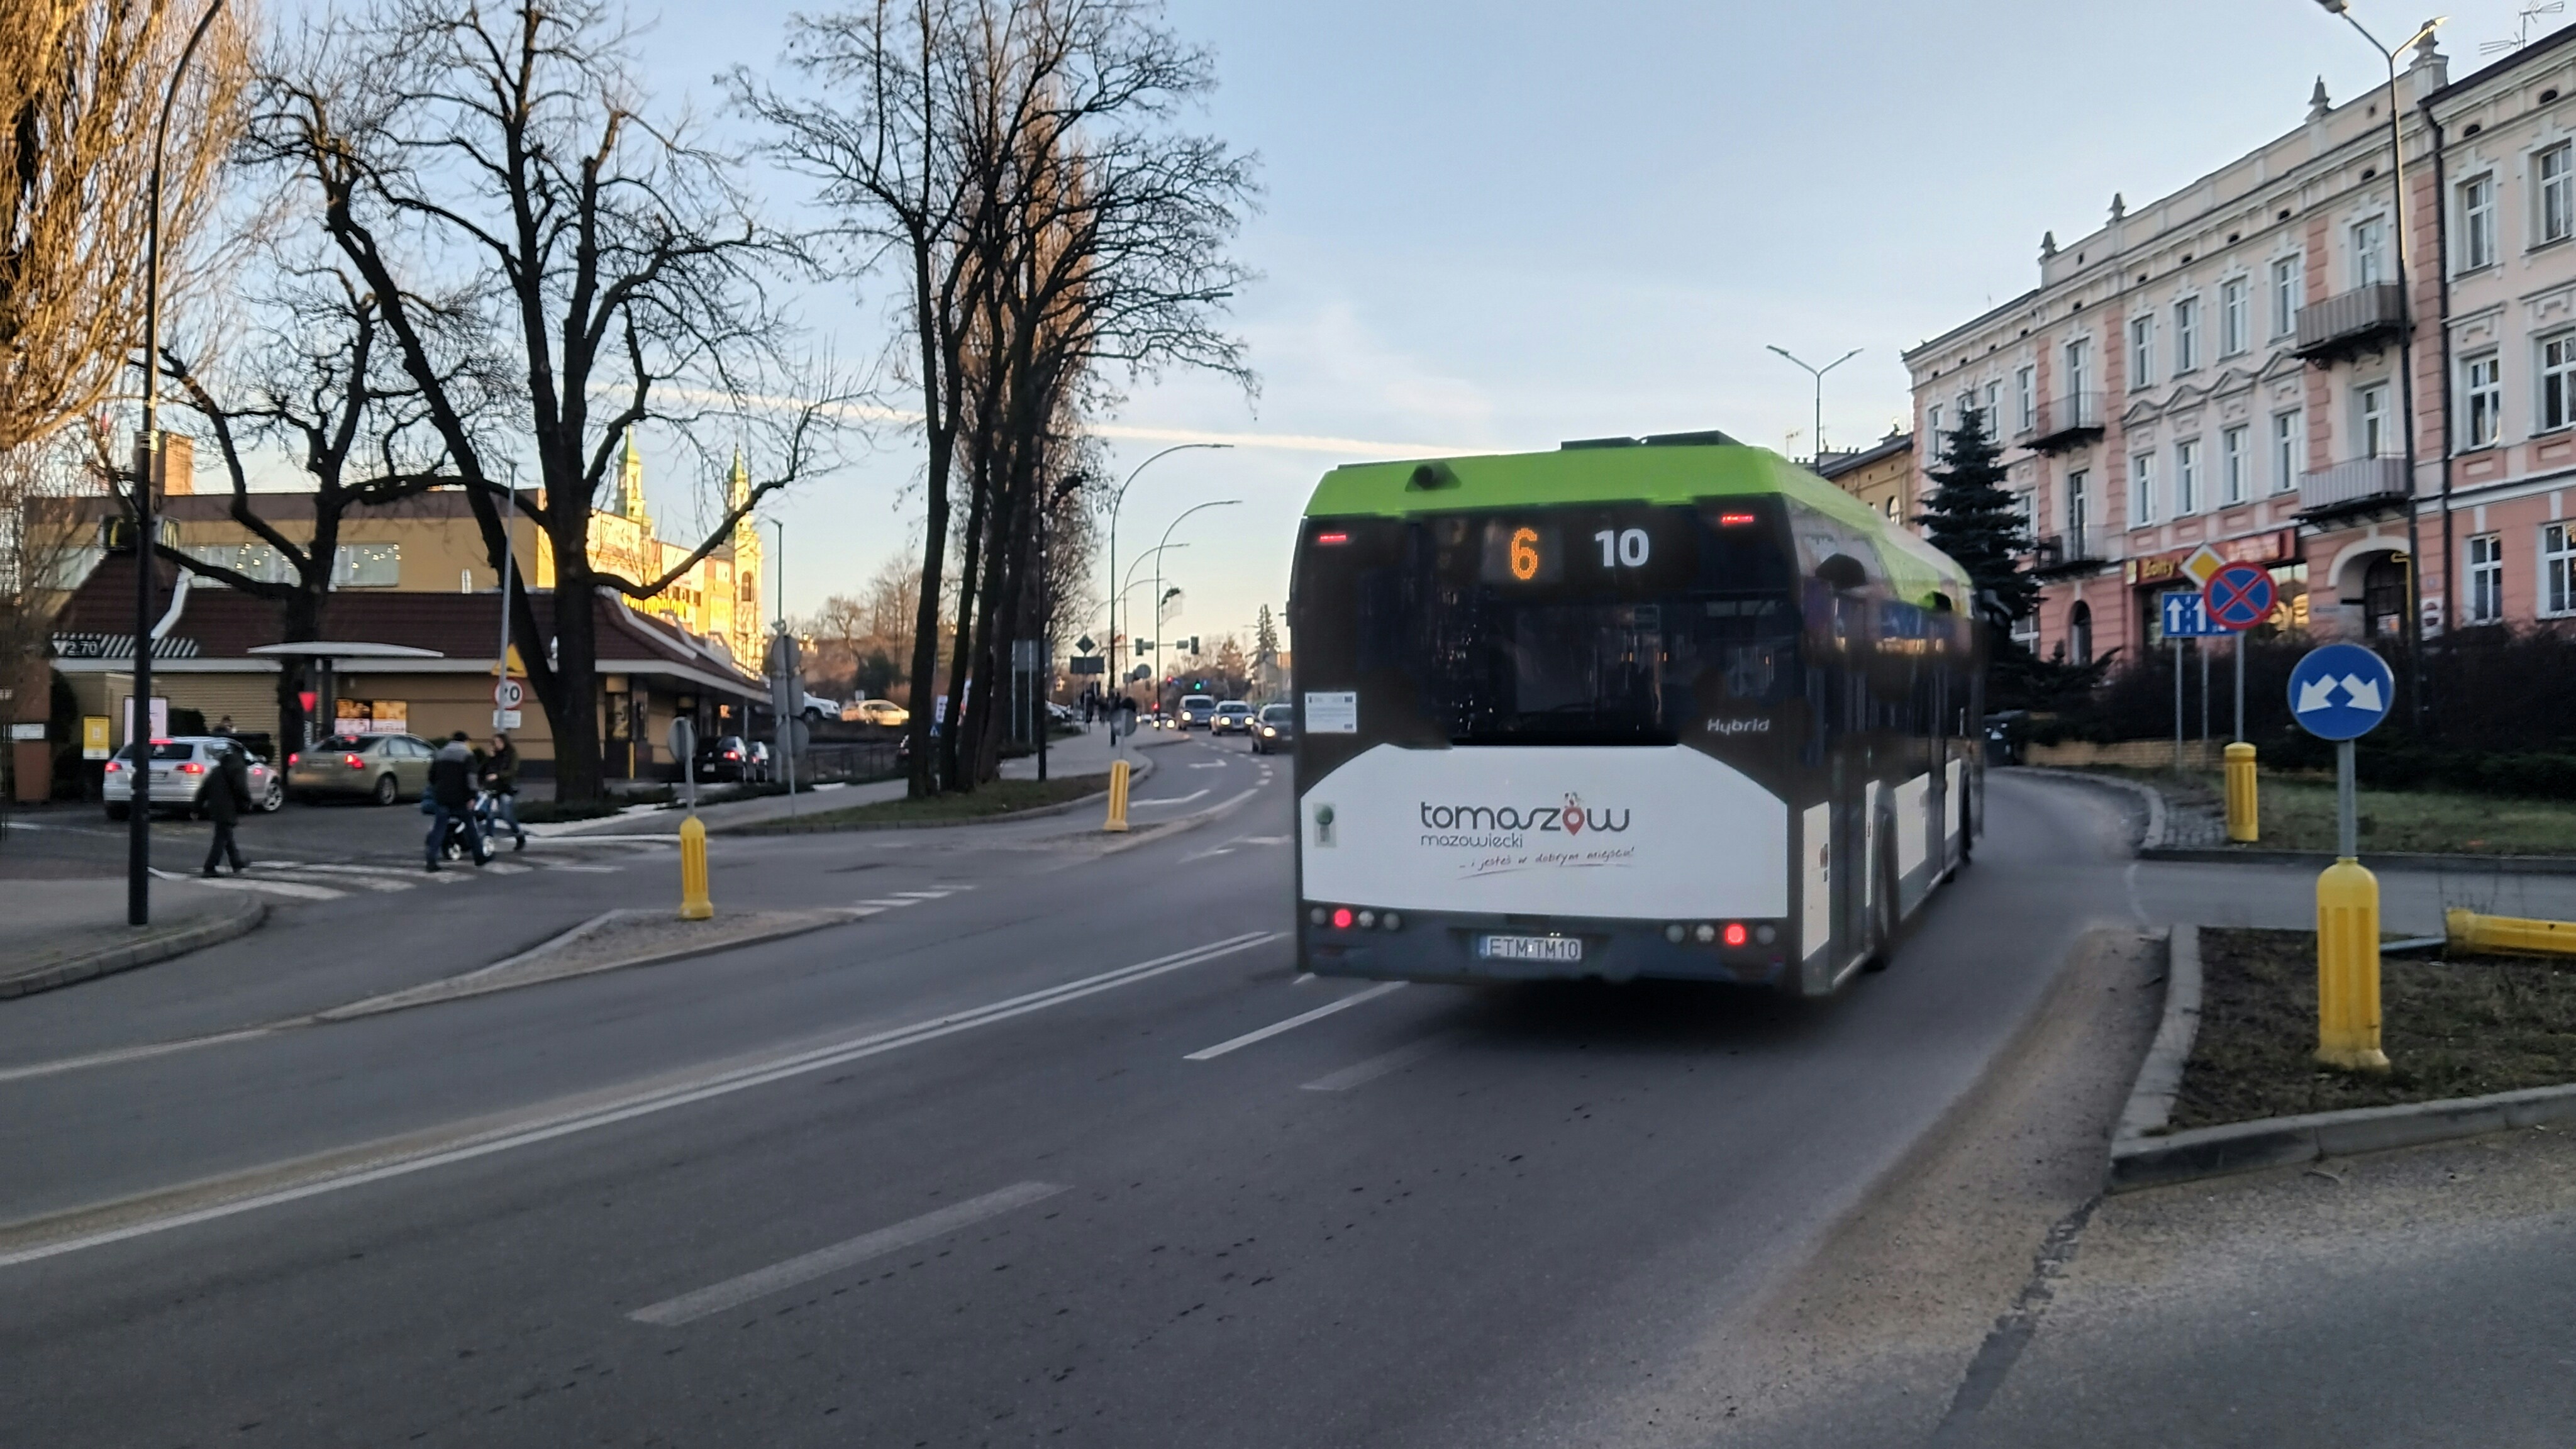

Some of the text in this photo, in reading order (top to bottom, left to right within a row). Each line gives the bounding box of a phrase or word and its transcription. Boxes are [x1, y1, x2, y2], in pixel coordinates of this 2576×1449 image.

[1511, 528, 1538, 579] 6
[1595, 528, 1649, 567] 10
[67, 641, 97, 655] 2.70
[1707, 718, 1770, 735] Hybrid
[1421, 833, 1523, 848] mazowiecki
[1518, 857, 1528, 865] w
[1535, 851, 1579, 868] dobrym
[1490, 938, 1579, 959] ETM TM10
